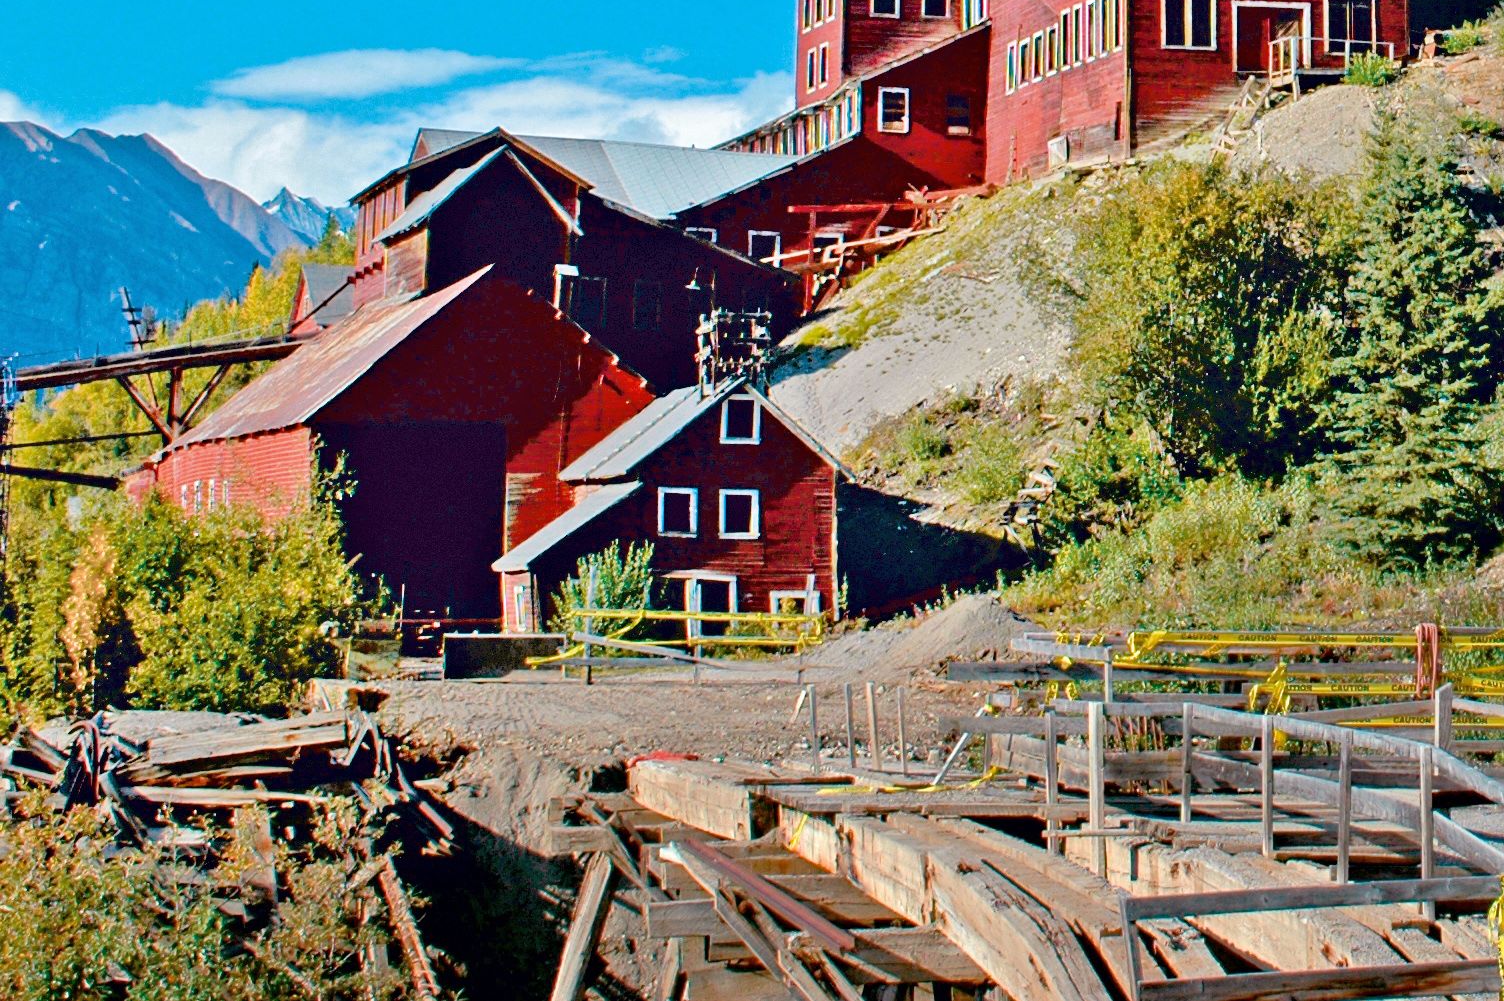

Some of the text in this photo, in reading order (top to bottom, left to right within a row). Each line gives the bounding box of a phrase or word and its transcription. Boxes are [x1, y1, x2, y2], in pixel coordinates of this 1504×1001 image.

[1238, 634, 1277, 642] CAUTION
[1299, 635, 1338, 643] CAUTION
[1355, 635, 1394, 643] CAUTION
[1330, 684, 1370, 692] CAUTION
